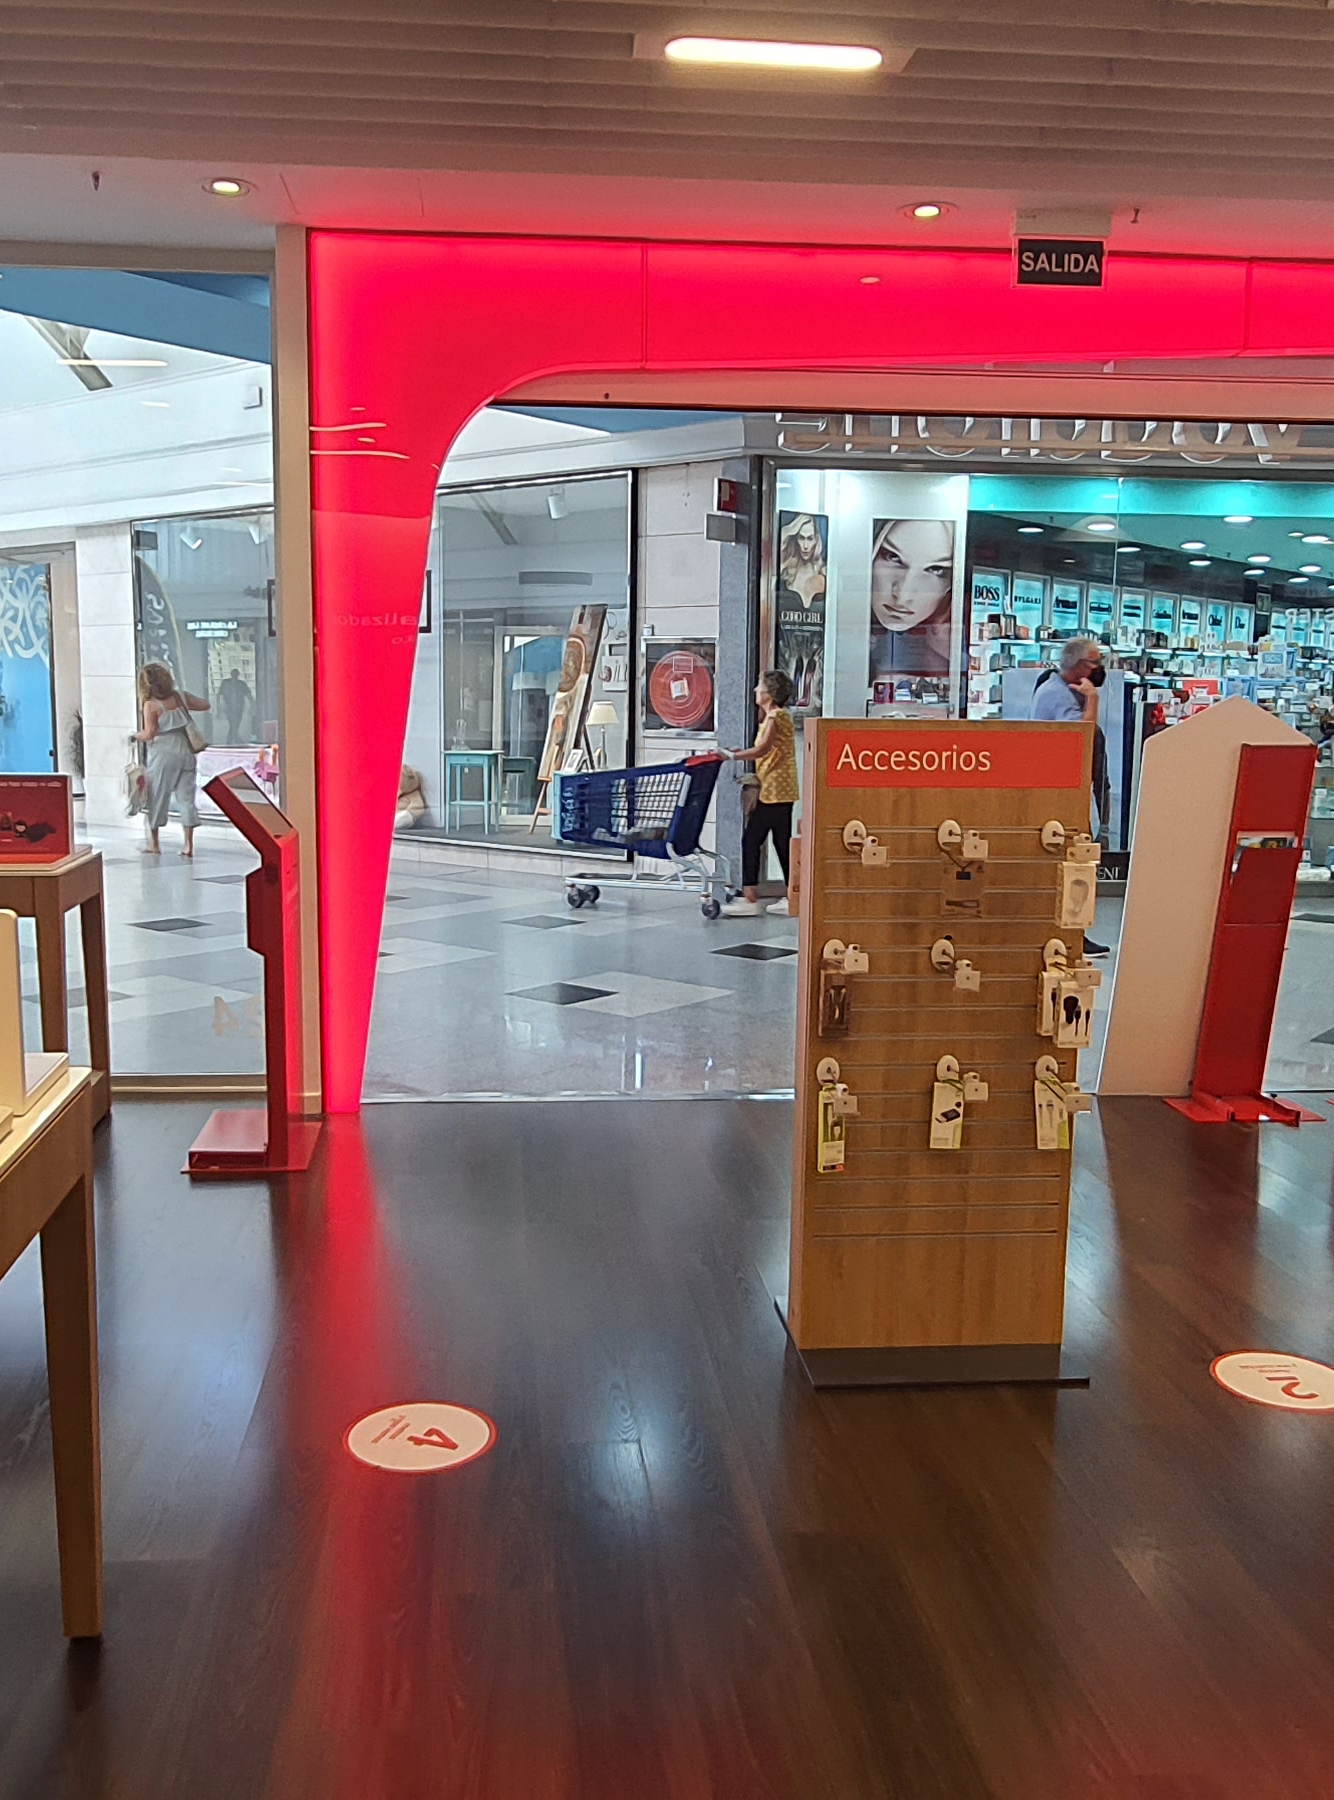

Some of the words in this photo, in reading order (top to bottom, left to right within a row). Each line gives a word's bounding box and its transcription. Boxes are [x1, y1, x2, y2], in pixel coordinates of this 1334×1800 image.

[1021, 251, 1100, 273] SALIDA
[974, 584, 1000, 602] BOSS
[803, 612, 823, 624] GIRL
[836, 743, 991, 772] Accesorios
[406, 1427, 459, 1451] 4
